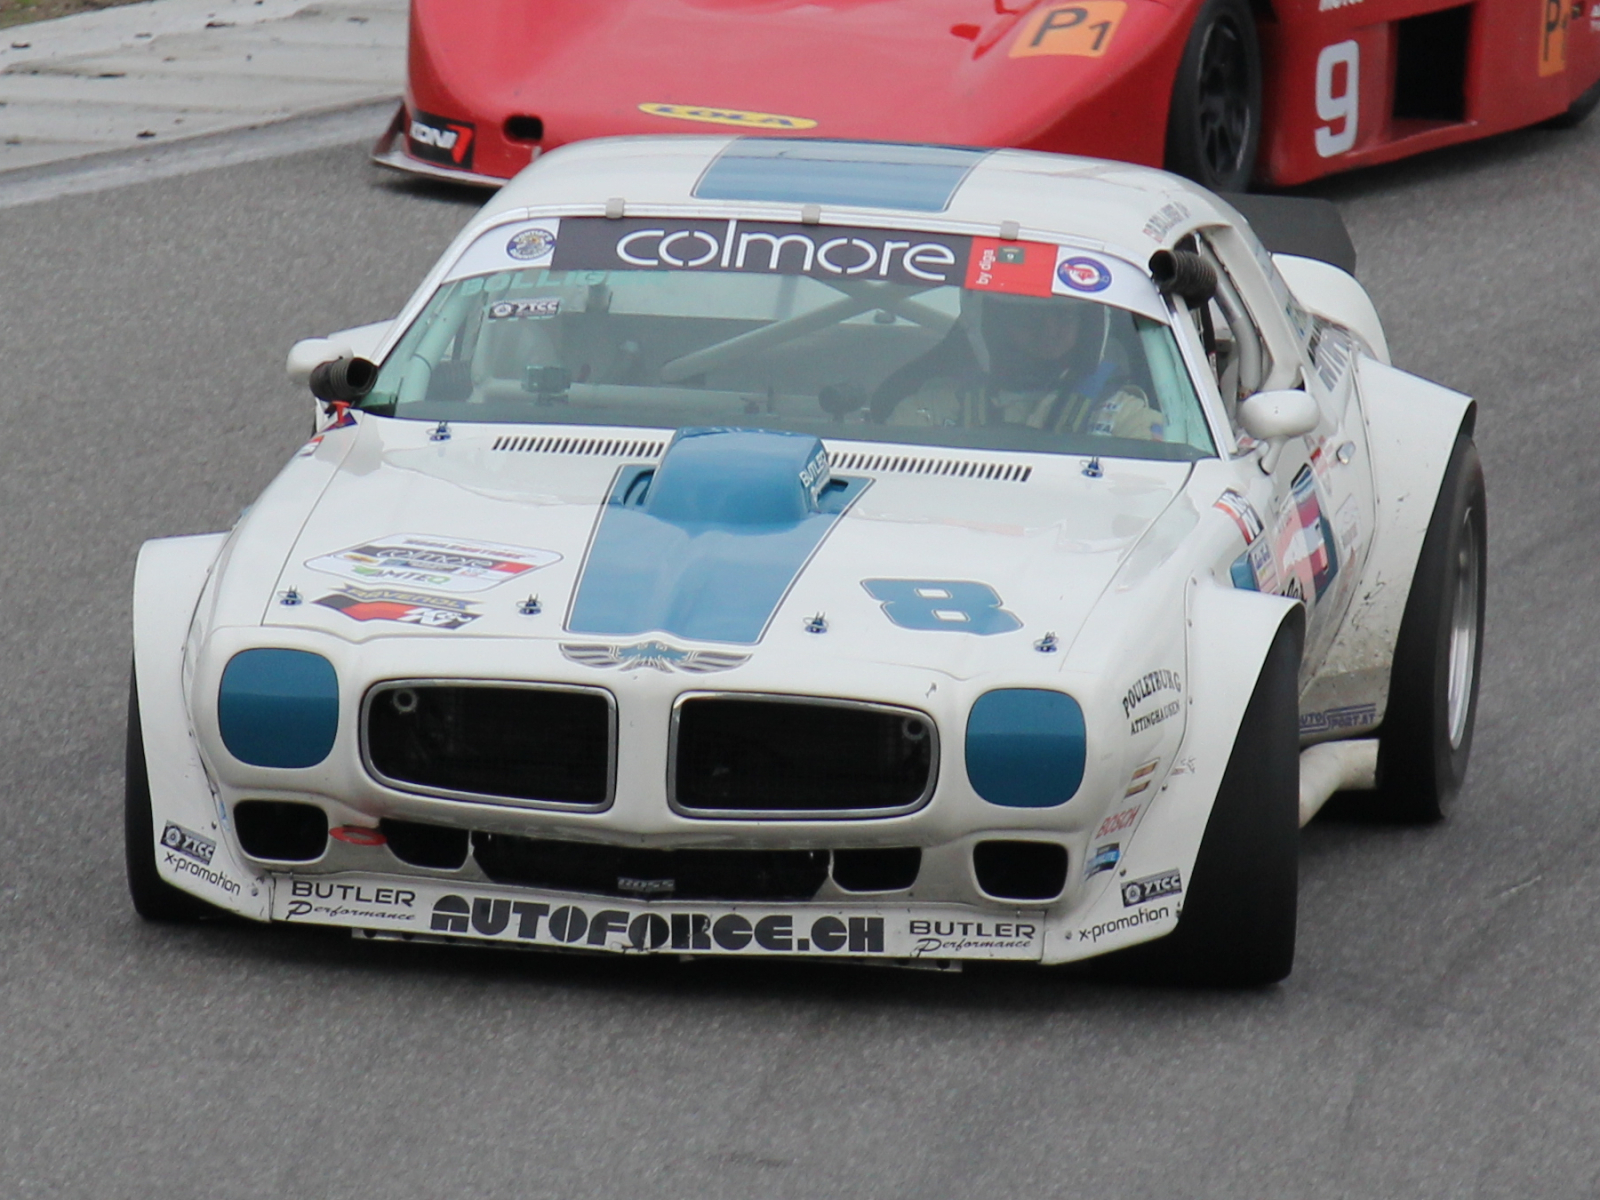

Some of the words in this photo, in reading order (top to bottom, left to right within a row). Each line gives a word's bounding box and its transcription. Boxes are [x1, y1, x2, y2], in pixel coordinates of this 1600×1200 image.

[1029, 7, 1112, 51] P1
[1314, 38, 1360, 158] 9
[616, 218, 956, 282] colmore
[860, 578, 1023, 636] 8
[163, 851, 242, 897] x-promotion
[292, 881, 416, 908] BUTLER
[285, 900, 416, 922] Performance
[430, 894, 884, 953] AUTOFORCE.CH
[909, 919, 1036, 940] BUTLER
[1079, 905, 1170, 942] x-promotion
[914, 937, 1032, 959] Performance
